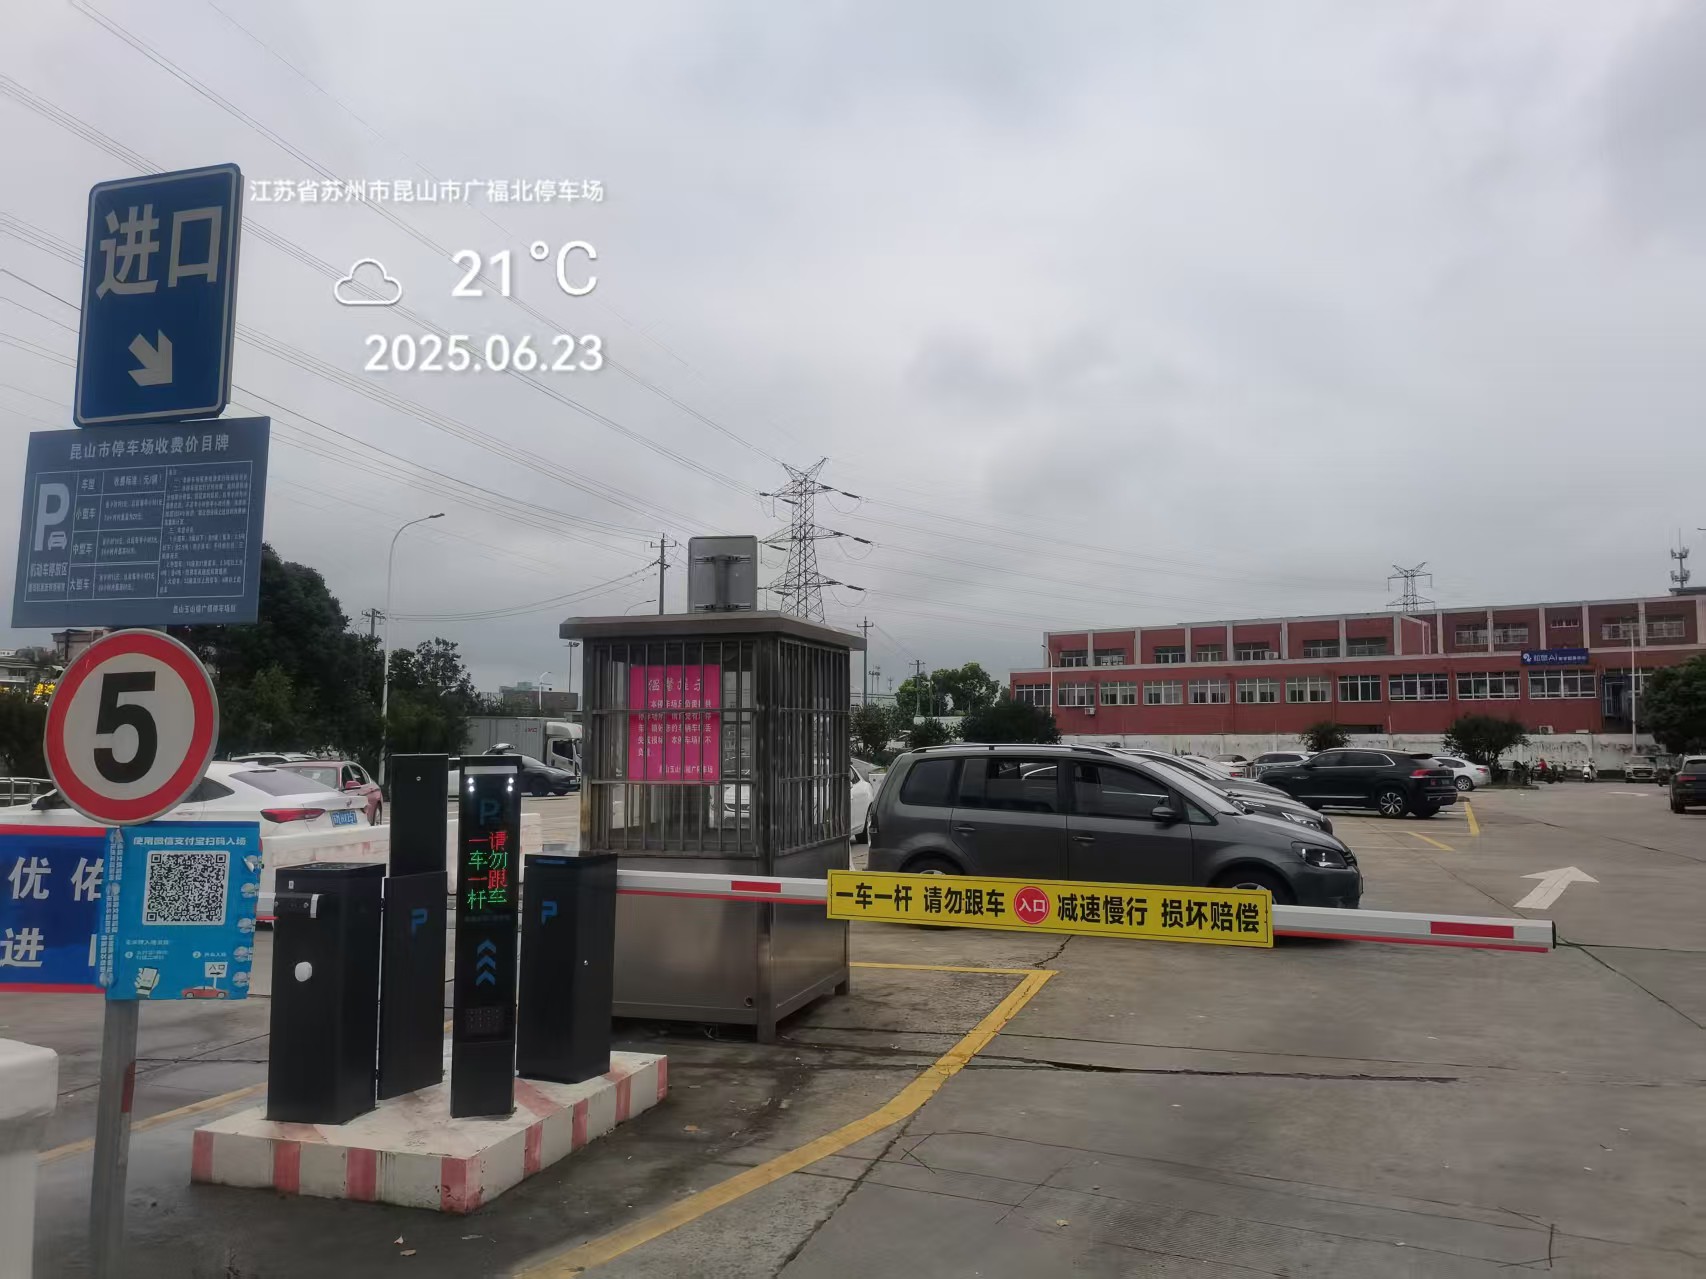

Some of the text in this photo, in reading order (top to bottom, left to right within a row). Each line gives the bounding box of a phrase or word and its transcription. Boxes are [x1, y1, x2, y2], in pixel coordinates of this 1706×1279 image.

[96, 203, 223, 300] 进口
[70, 434, 229, 460] 昆山市停车场收费价目牌
[34, 483, 70, 551] P
[93, 671, 158, 783] 5
[133, 836, 247, 846] 使用微信支付宝扫码入场
[835, 882, 1260, 933] 一车一杆 请勿跟车 入口 减速慢行 损坏赔偿
